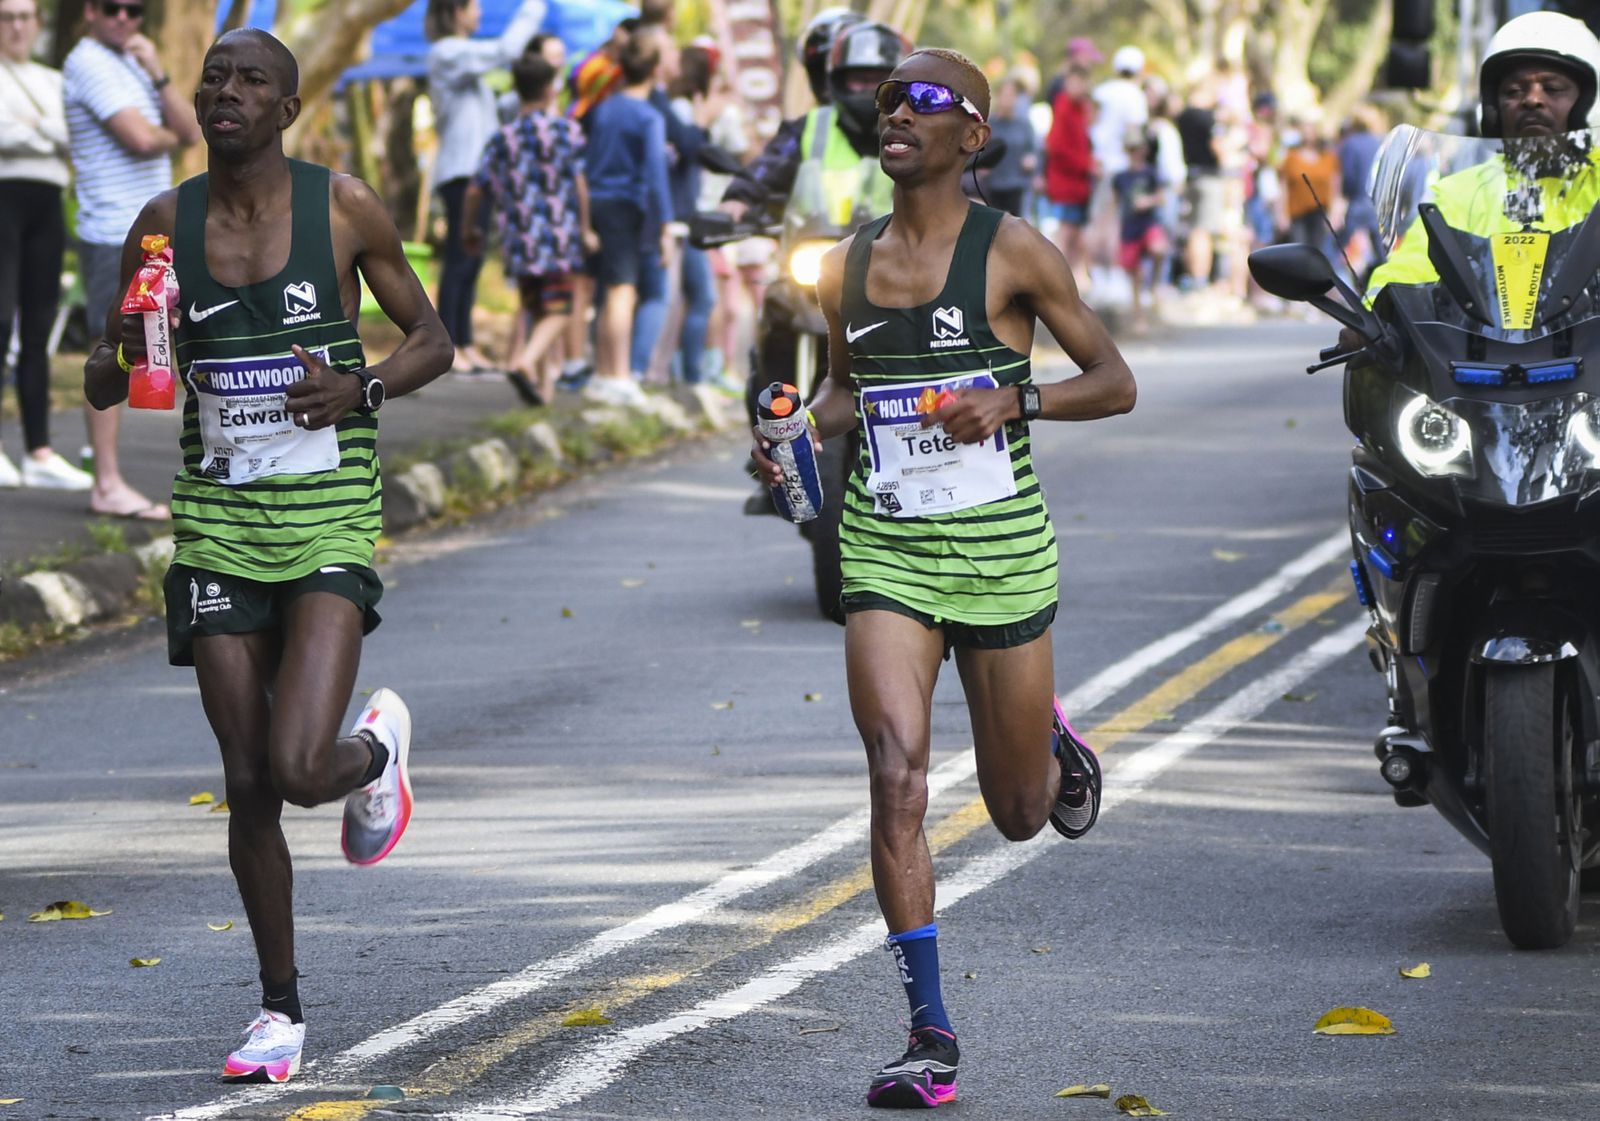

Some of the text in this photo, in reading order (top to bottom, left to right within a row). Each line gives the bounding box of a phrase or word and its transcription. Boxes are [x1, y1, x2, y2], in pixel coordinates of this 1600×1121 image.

[1504, 235, 1535, 245] 2022
[1496, 264, 1512, 326] MOTORBIKE
[1523, 263, 1543, 326] FULL ROUTE
[282, 312, 321, 325] NEDBANK
[930, 338, 970, 349] NEDBANK
[210, 365, 305, 390] HOLLYWOOD
[879, 396, 926, 419] HOLLY
[218, 407, 289, 427] Edwar
[901, 434, 956, 456] Tete
[211, 458, 229, 471] ASA
[876, 480, 900, 491] A28951
[947, 491, 954, 501] 1
[197, 597, 231, 606] NEDBANK
[198, 605, 219, 613] Running
